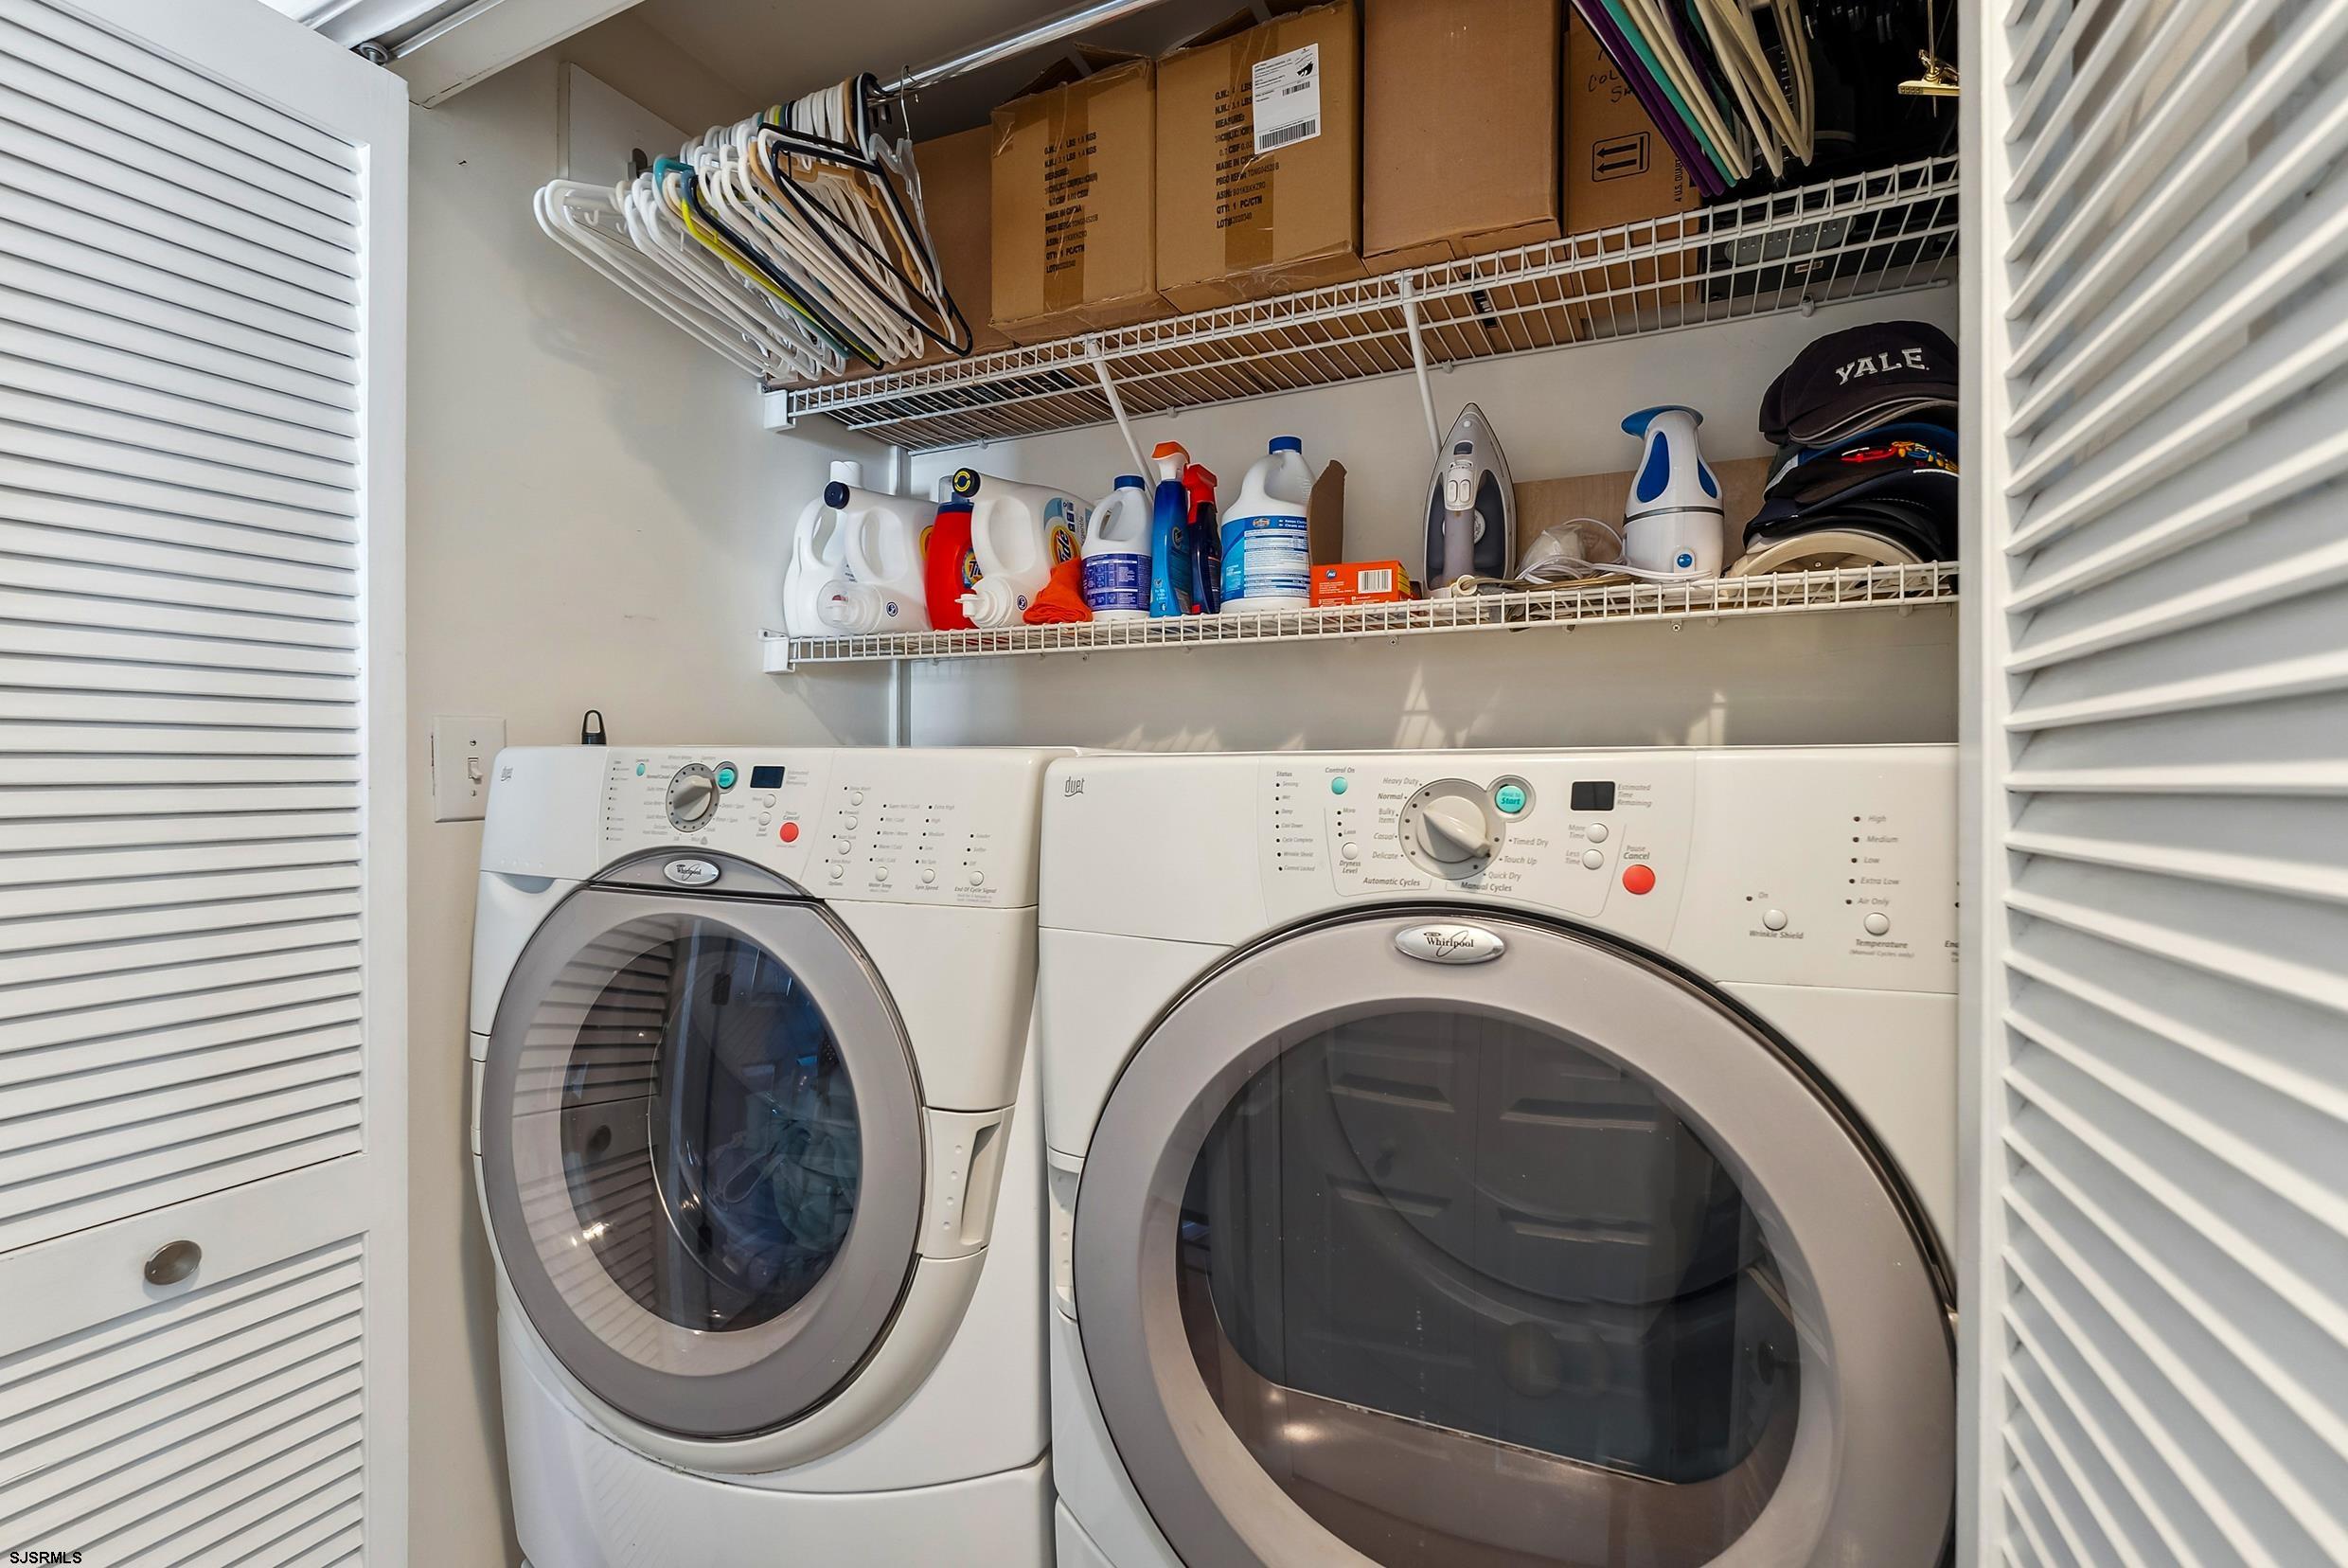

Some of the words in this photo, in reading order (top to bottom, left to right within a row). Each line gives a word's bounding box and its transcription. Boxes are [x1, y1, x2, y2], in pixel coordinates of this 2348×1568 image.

[1216, 159, 1233, 171] MADE
[1233, 157, 1239, 168] IN
[1064, 775, 1085, 794] duet
[1382, 777, 1402, 786] Heavy
[1403, 777, 1418, 786] Duty
[1617, 799, 1652, 809] Remaining
[1868, 815, 1887, 824] High
[1513, 837, 1535, 846] Timed
[1537, 838, 1549, 847] Dry
[1866, 835, 1898, 844] Medium
[1372, 851, 1398, 860] Delicate
[1623, 851, 1650, 860] Cancel
[1527, 856, 1538, 865] Up
[1565, 857, 1580, 865] Time
[1488, 871, 1507, 880] Quick
[1508, 871, 1521, 882] Dry
[1860, 877, 1882, 885] Extra
[1362, 877, 1398, 885] Automatic
[1399, 878, 1421, 887] Cycles
[1461, 882, 1488, 890] Manual
[1489, 883, 1512, 893] Cycles
[1872, 898, 1890, 907] Only
[1749, 930, 1778, 938] Wrinkle
[1779, 931, 1804, 940] Shield
[1426, 934, 1474, 953] Whirlpool
[1856, 939, 1908, 950] Temperature
[1849, 949, 1877, 957] (Manual
